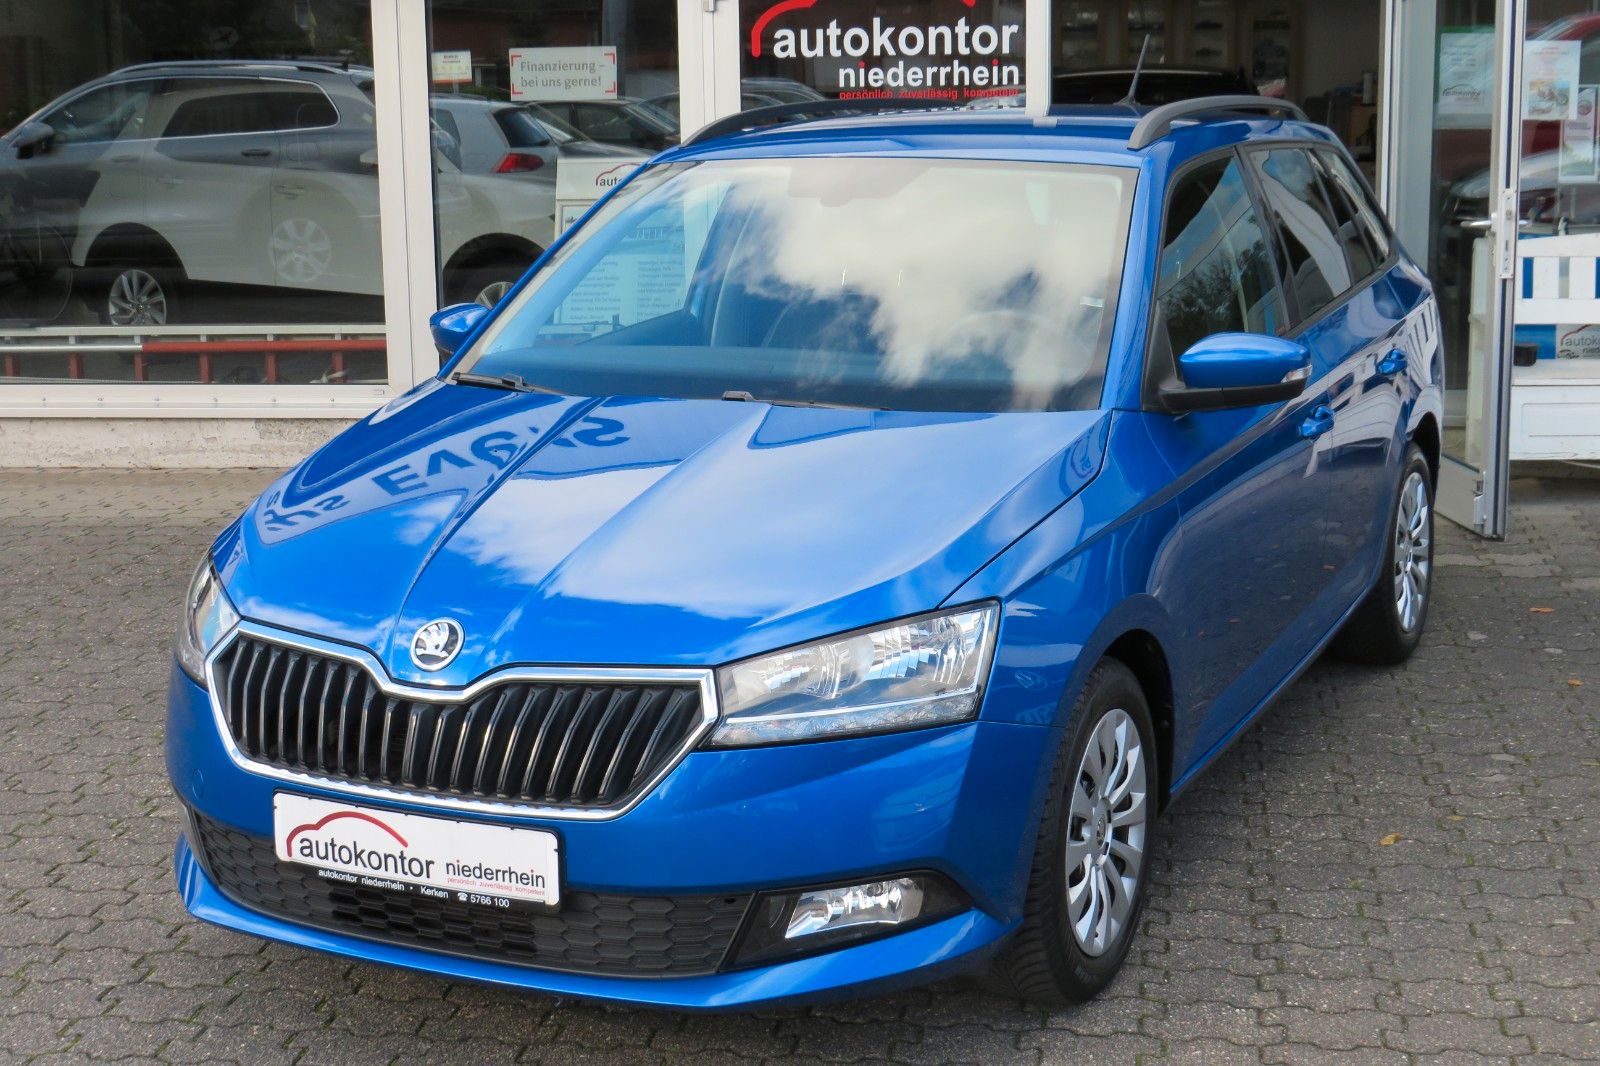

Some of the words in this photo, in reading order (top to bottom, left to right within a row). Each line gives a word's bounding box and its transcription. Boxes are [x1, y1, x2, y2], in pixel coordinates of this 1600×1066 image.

[773, 16, 1019, 58] autokontor
[520, 61, 596, 73] Finanzierung
[520, 76, 539, 87] bei
[542, 78, 562, 87] uns
[564, 76, 602, 90] gerne!
[838, 59, 1019, 88] niederrhein
[299, 837, 435, 879] autokontor
[445, 859, 546, 889] niederrhein
[318, 869, 358, 884] autokontor
[361, 876, 405, 891] niederrhein
[420, 886, 449, 899] Kerken
[470, 894, 492, 905] 5766
[494, 897, 510, 908] 100
